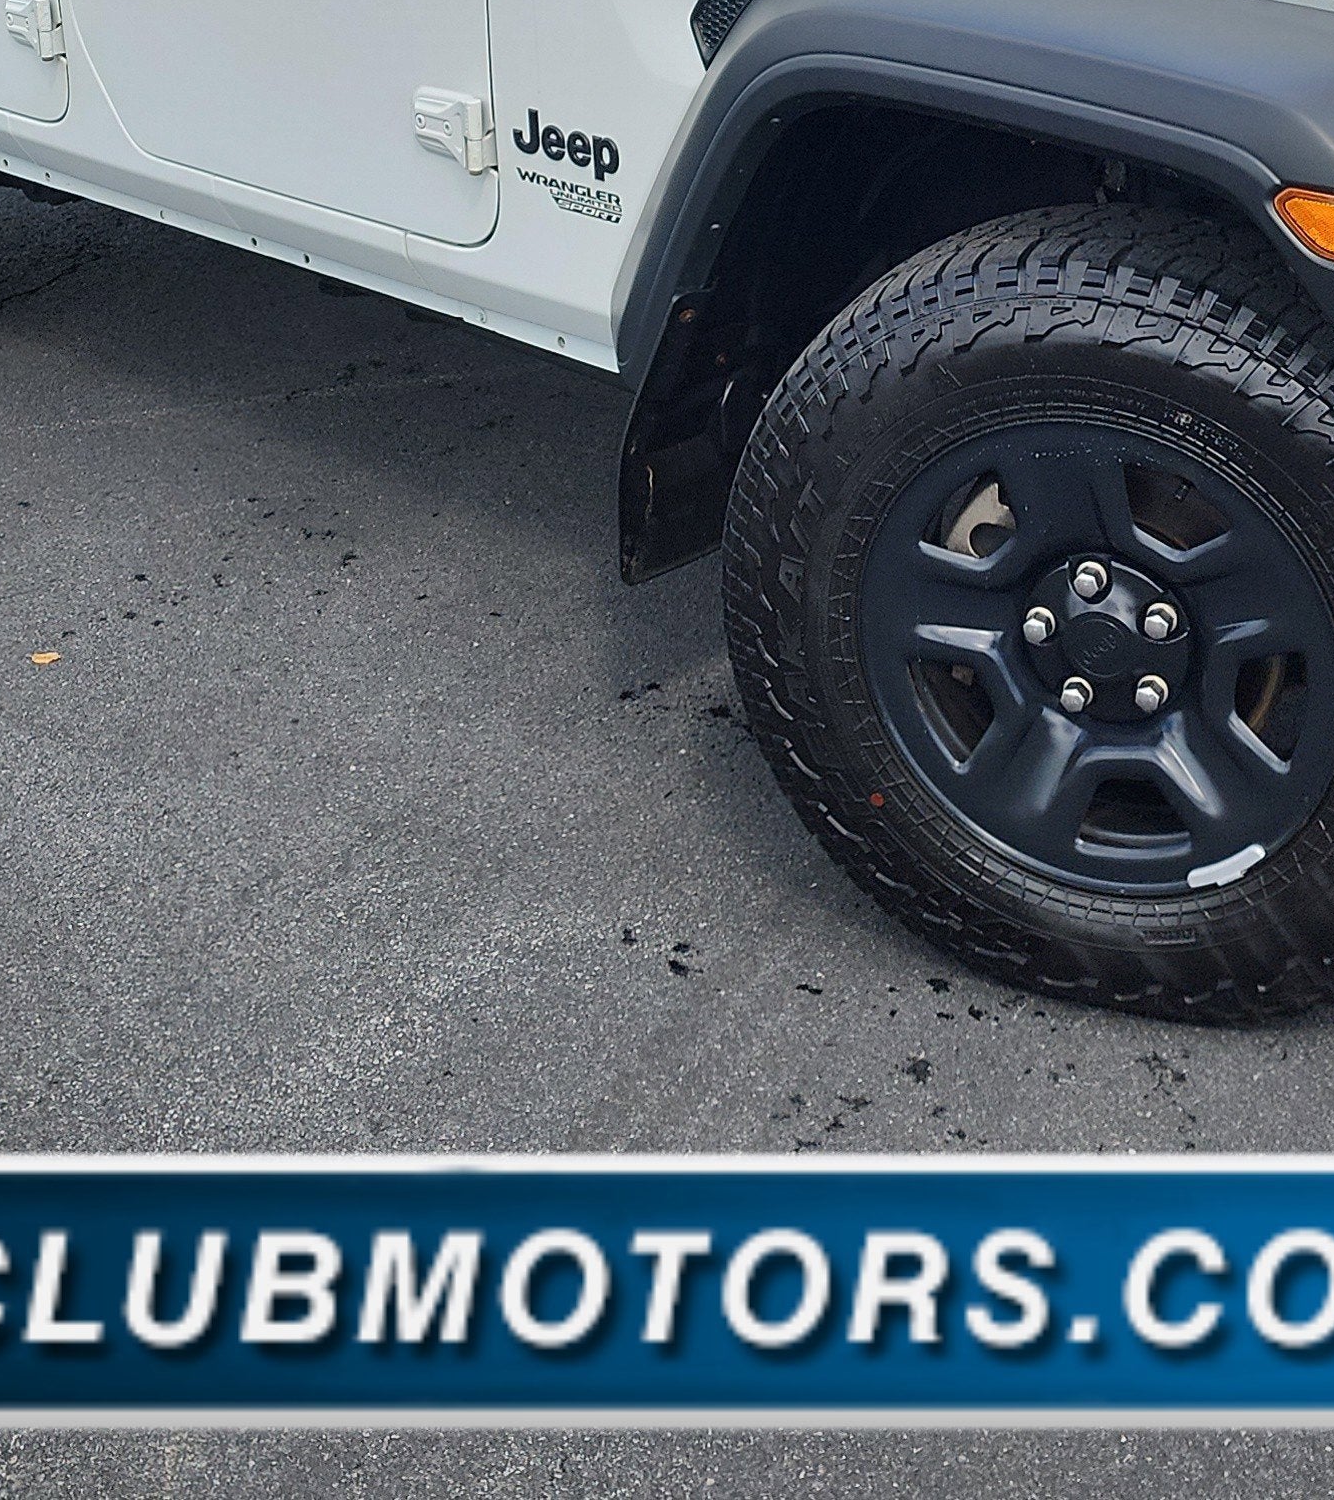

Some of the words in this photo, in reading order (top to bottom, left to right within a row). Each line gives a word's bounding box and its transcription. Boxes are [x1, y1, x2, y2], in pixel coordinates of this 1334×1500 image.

[512, 108, 620, 182] Jeep
[516, 167, 621, 207] WRANGLER
[549, 188, 623, 213] UNLIMITED
[556, 199, 621, 222] SPORT
